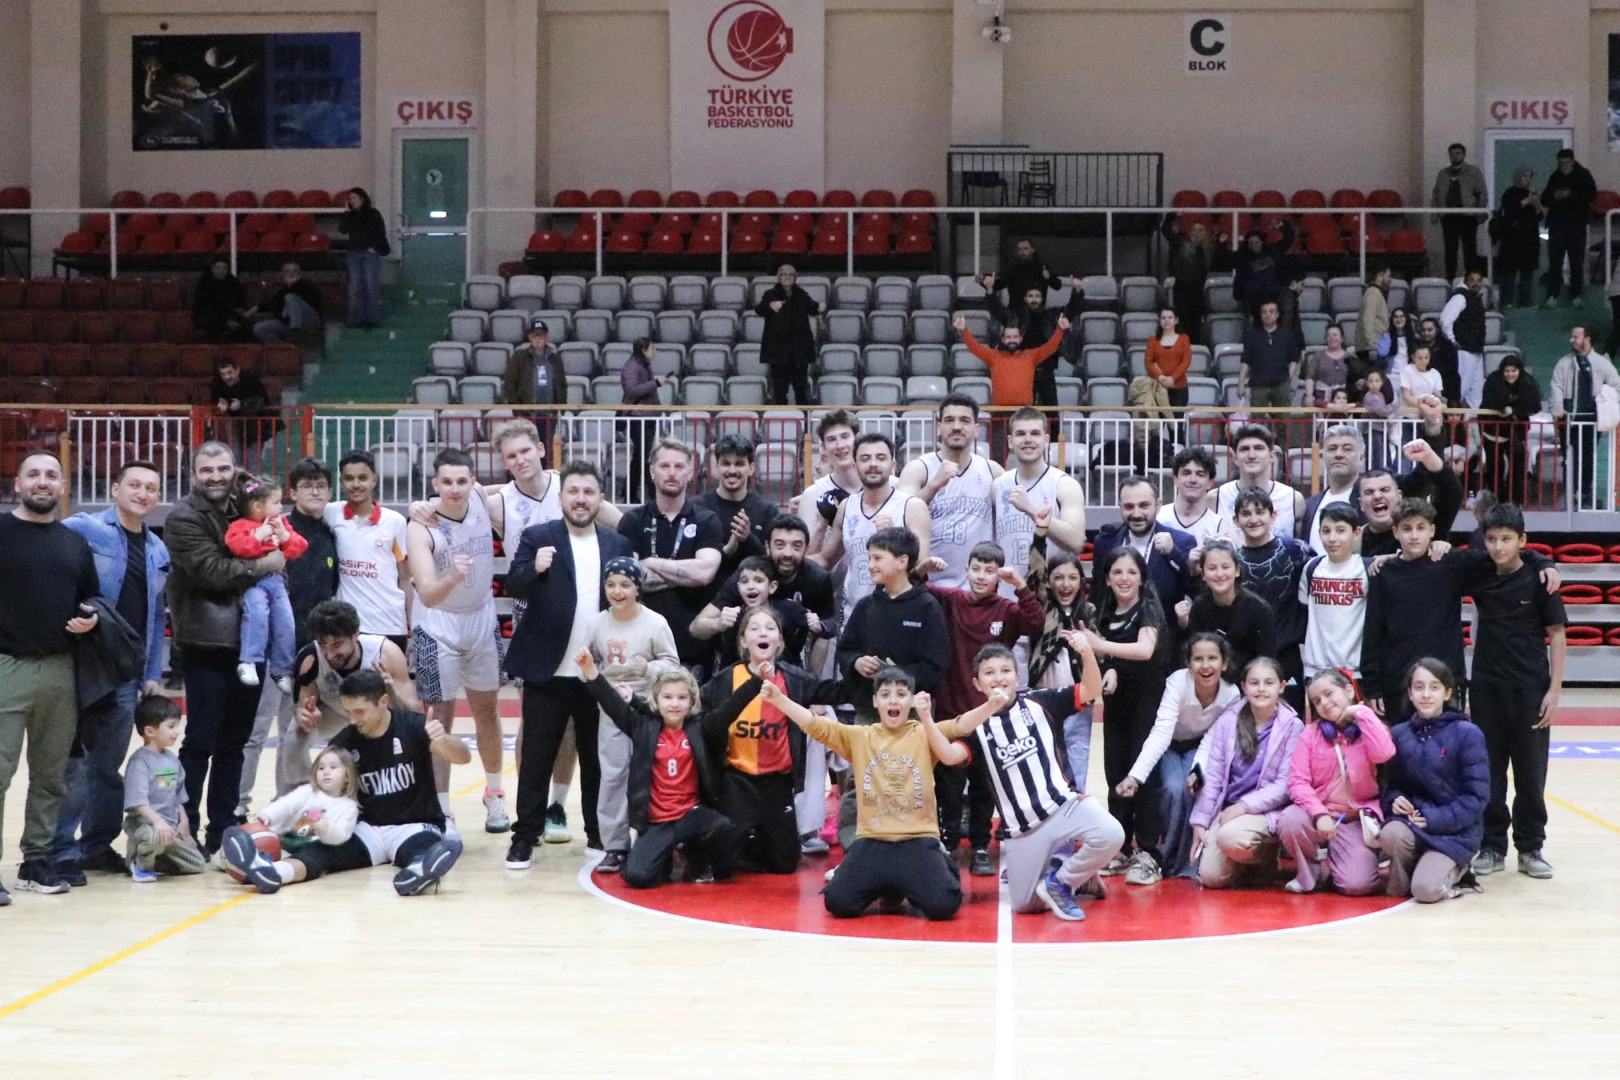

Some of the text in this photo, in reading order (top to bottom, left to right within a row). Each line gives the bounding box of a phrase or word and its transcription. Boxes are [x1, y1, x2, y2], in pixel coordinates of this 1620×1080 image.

[1190, 18, 1225, 56] C
[1188, 60, 1227, 71] BLOK
[707, 84, 793, 105] TÜRKİYE
[397, 101, 473, 125] ÇIKIŞ
[707, 105, 793, 117] BASKETBOL
[1490, 100, 1569, 125] ÇIKIŞ
[707, 118, 793, 128] FEDERASYONU
[1012, 538, 1031, 566] 12
[1311, 579, 1364, 596] STRANGER
[1315, 593, 1353, 606] THINGS
[995, 736, 1037, 760] beko
[667, 758, 678, 777] 8
[863, 758, 876, 792] BORN
[900, 754, 923, 809] SURVIVE
